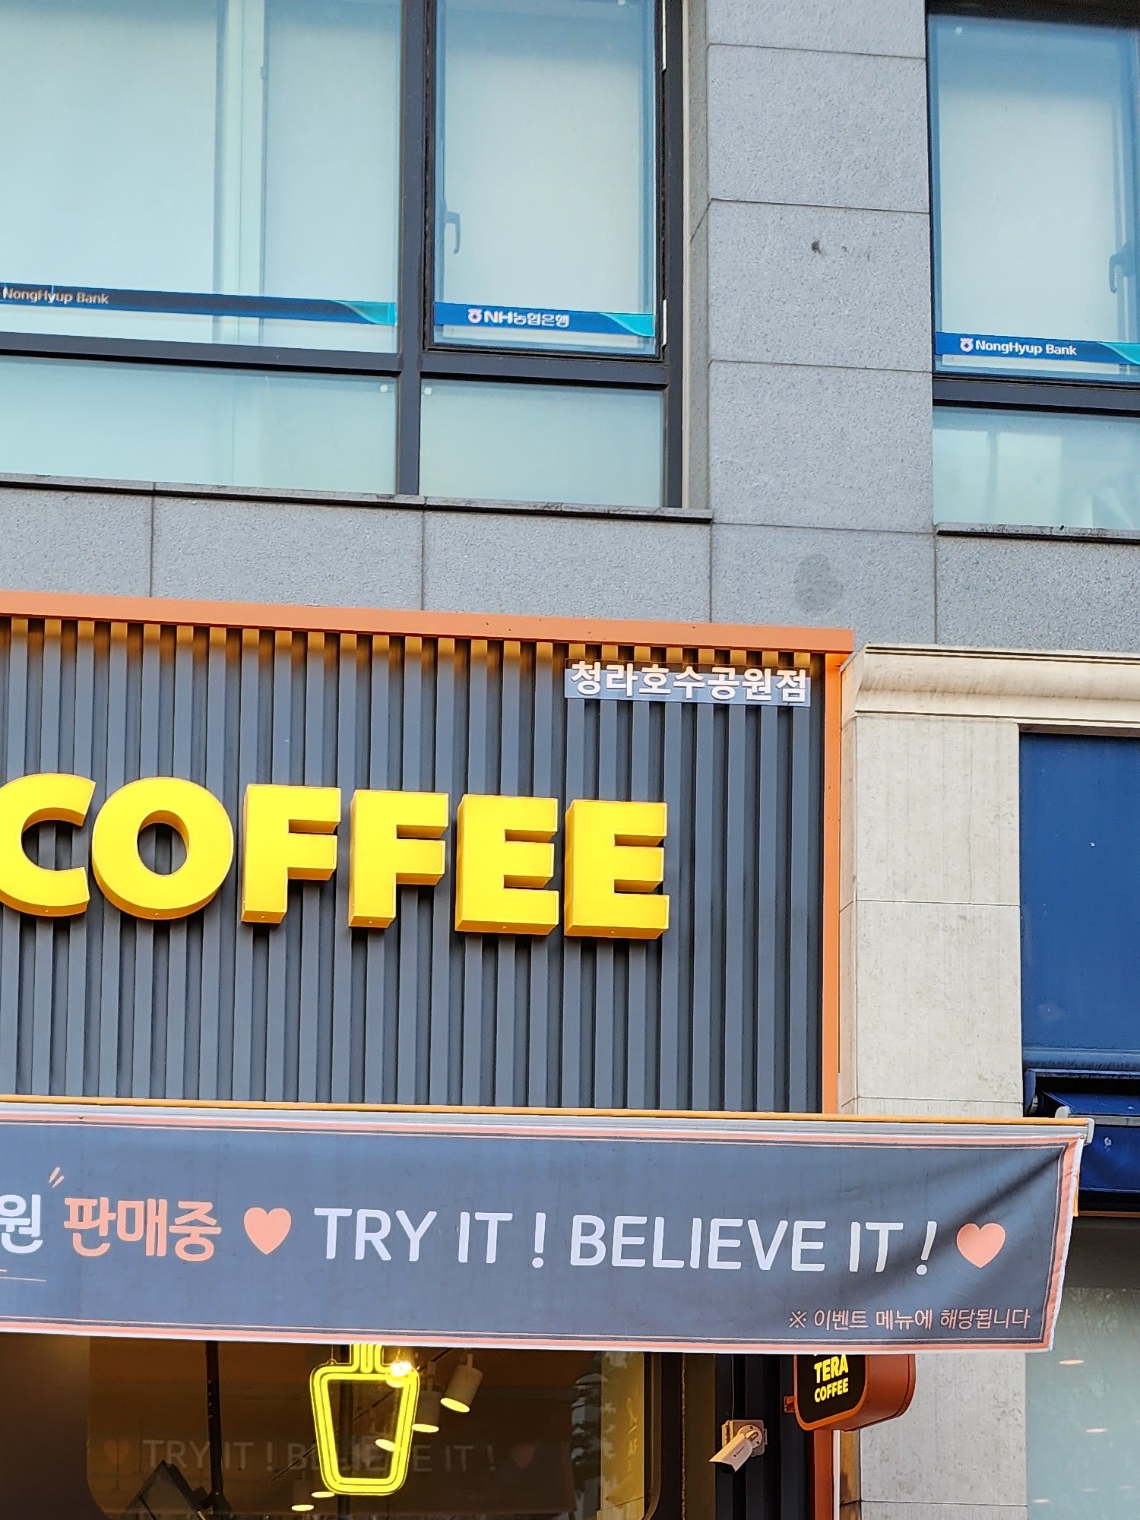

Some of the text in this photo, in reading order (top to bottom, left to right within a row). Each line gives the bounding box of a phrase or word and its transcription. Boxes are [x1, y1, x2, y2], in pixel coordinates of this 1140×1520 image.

[3, 286, 109, 305] NongHyup Bank
[483, 309, 570, 328] NH농협은행
[975, 338, 1078, 357] NongHyup Bank
[571, 660, 807, 703] 청라호수공원점
[63, 1196, 223, 1262] 판매중
[314, 1207, 437, 1262] TRY
[458, 1211, 513, 1265] IT
[571, 1216, 826, 1272] BELIEVE
[849, 1221, 904, 1274] IT
[814, 1309, 869, 1331] 이벤트
[875, 1308, 933, 1331] 메뉴에
[940, 1308, 1031, 1330] 해당됩니다
[814, 1354, 849, 1384] TERA
[814, 1377, 849, 1403] COFFEE
[143, 1439, 211, 1469] TRY
